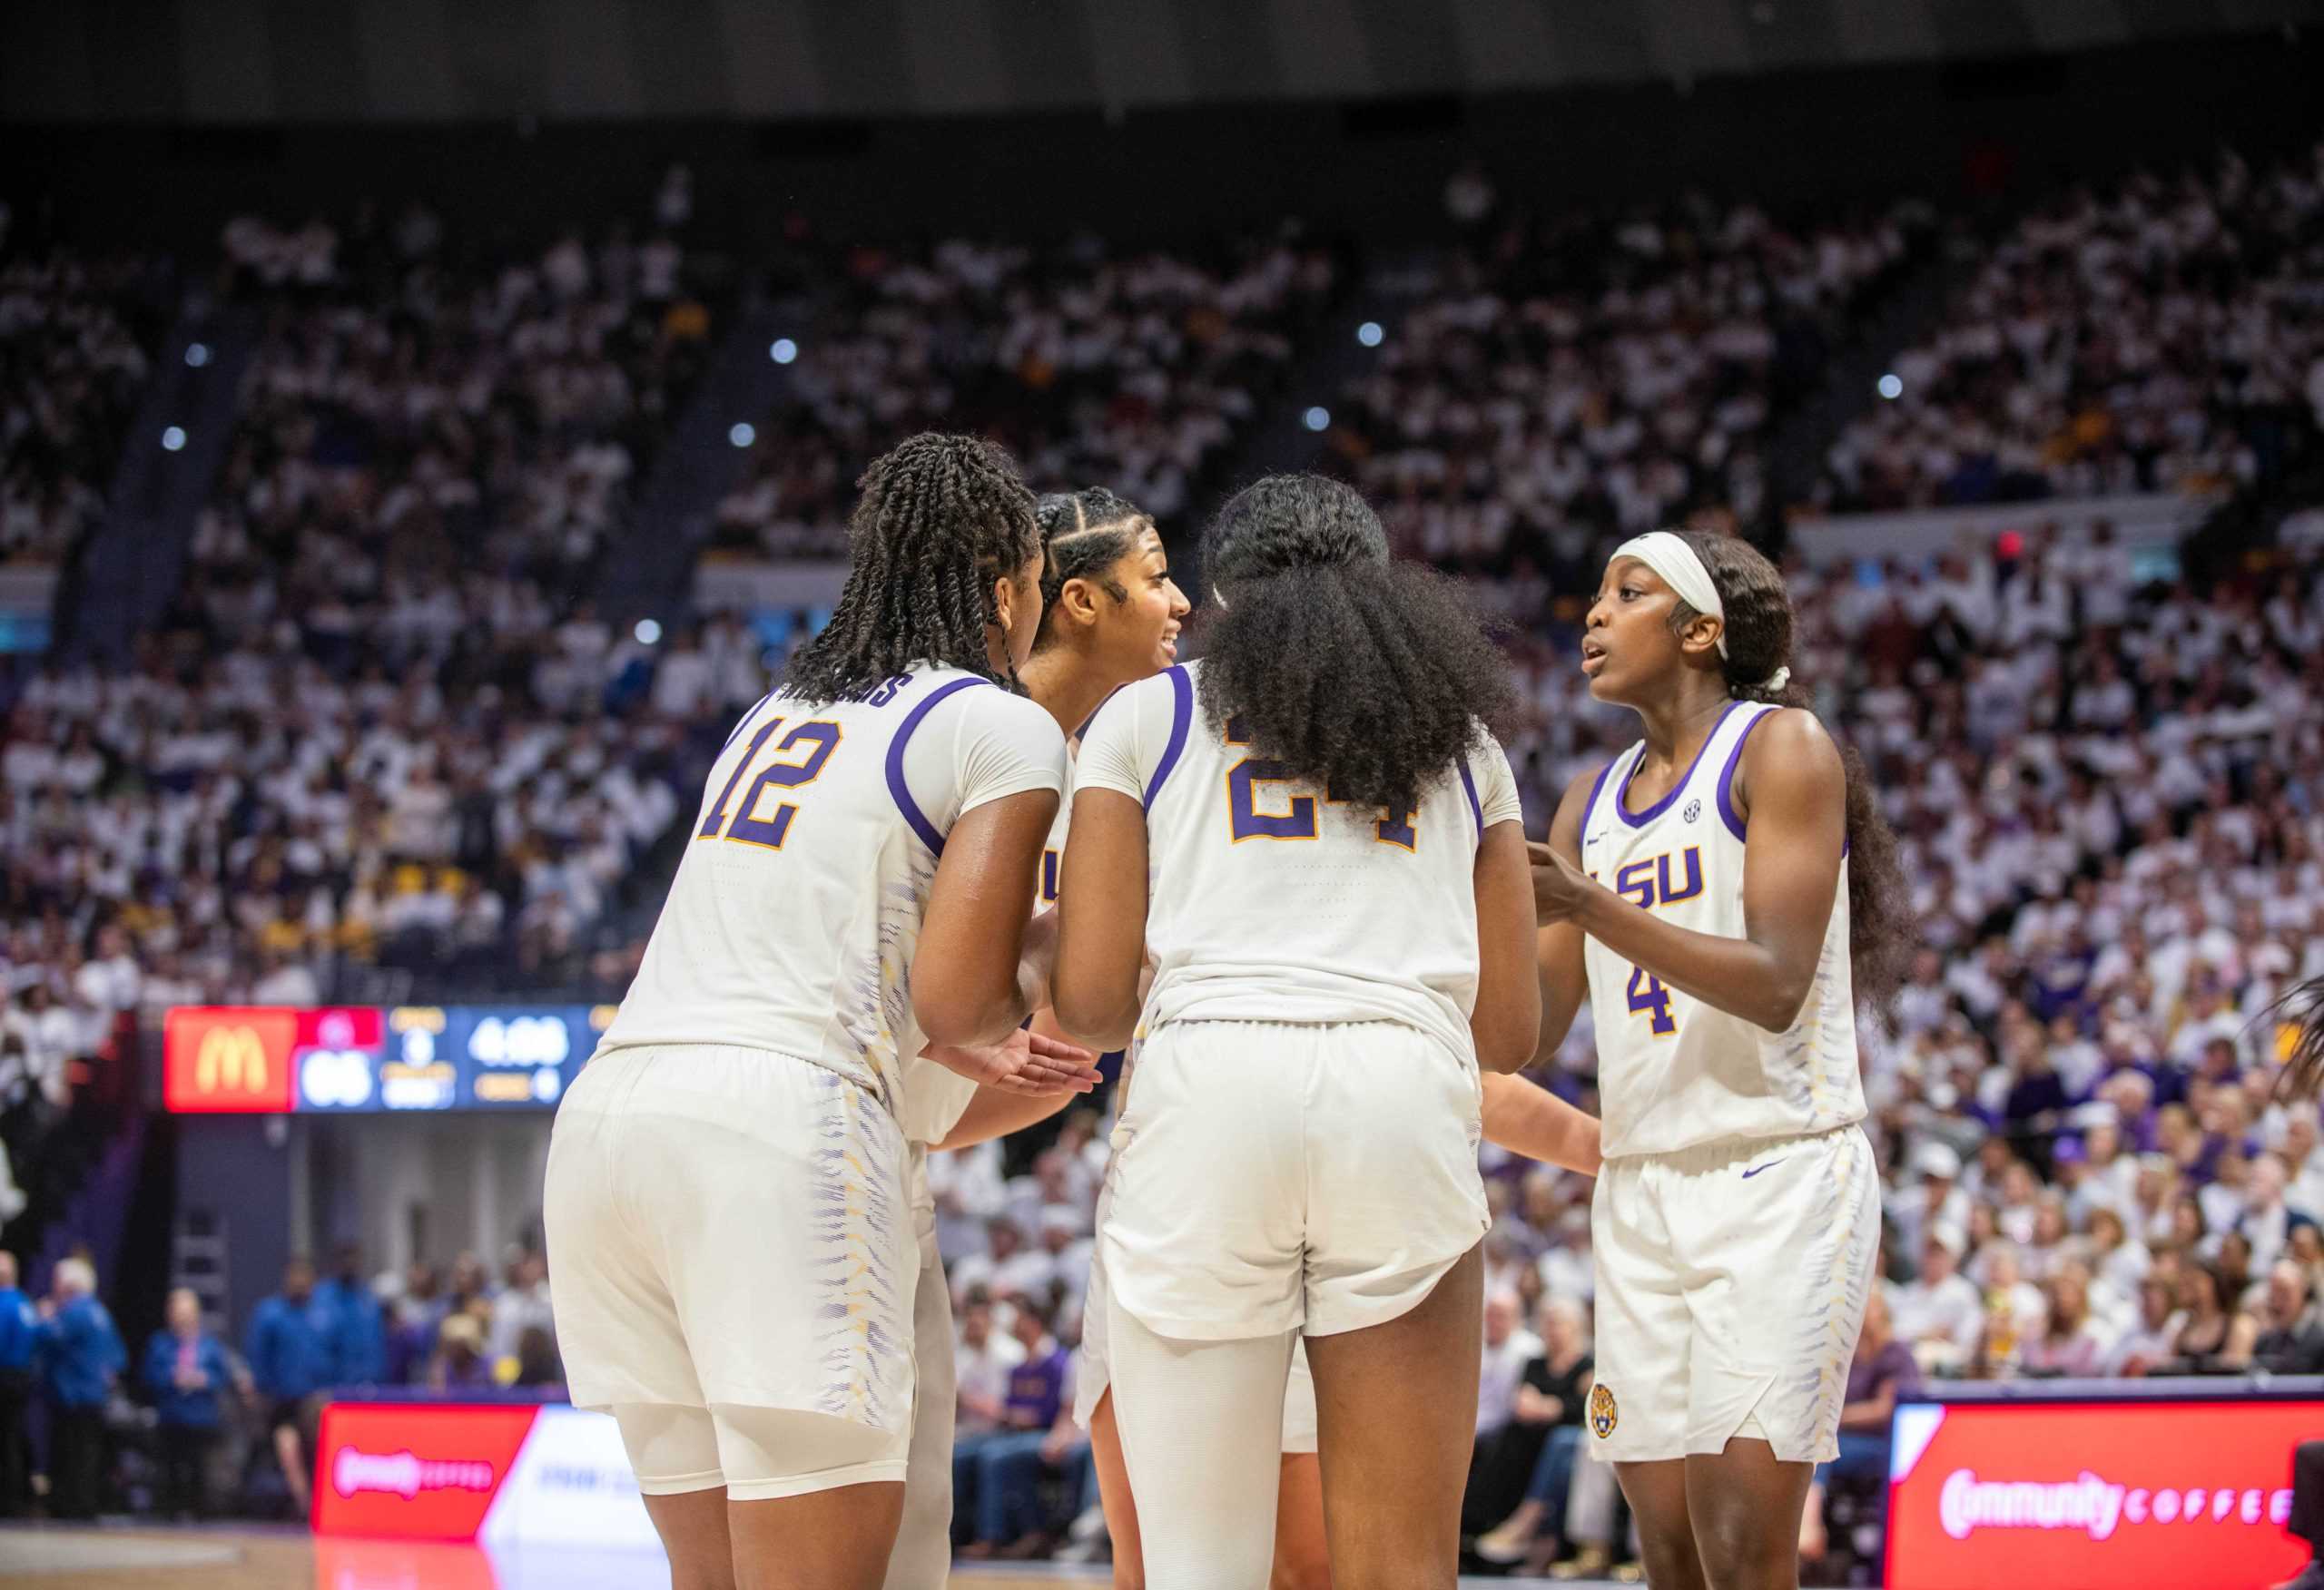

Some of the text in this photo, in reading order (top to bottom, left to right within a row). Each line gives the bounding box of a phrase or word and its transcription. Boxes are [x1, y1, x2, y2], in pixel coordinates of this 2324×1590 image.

[696, 717, 843, 851] 12
[1589, 845, 1705, 910] SU
[1626, 961, 1678, 1038] 4
